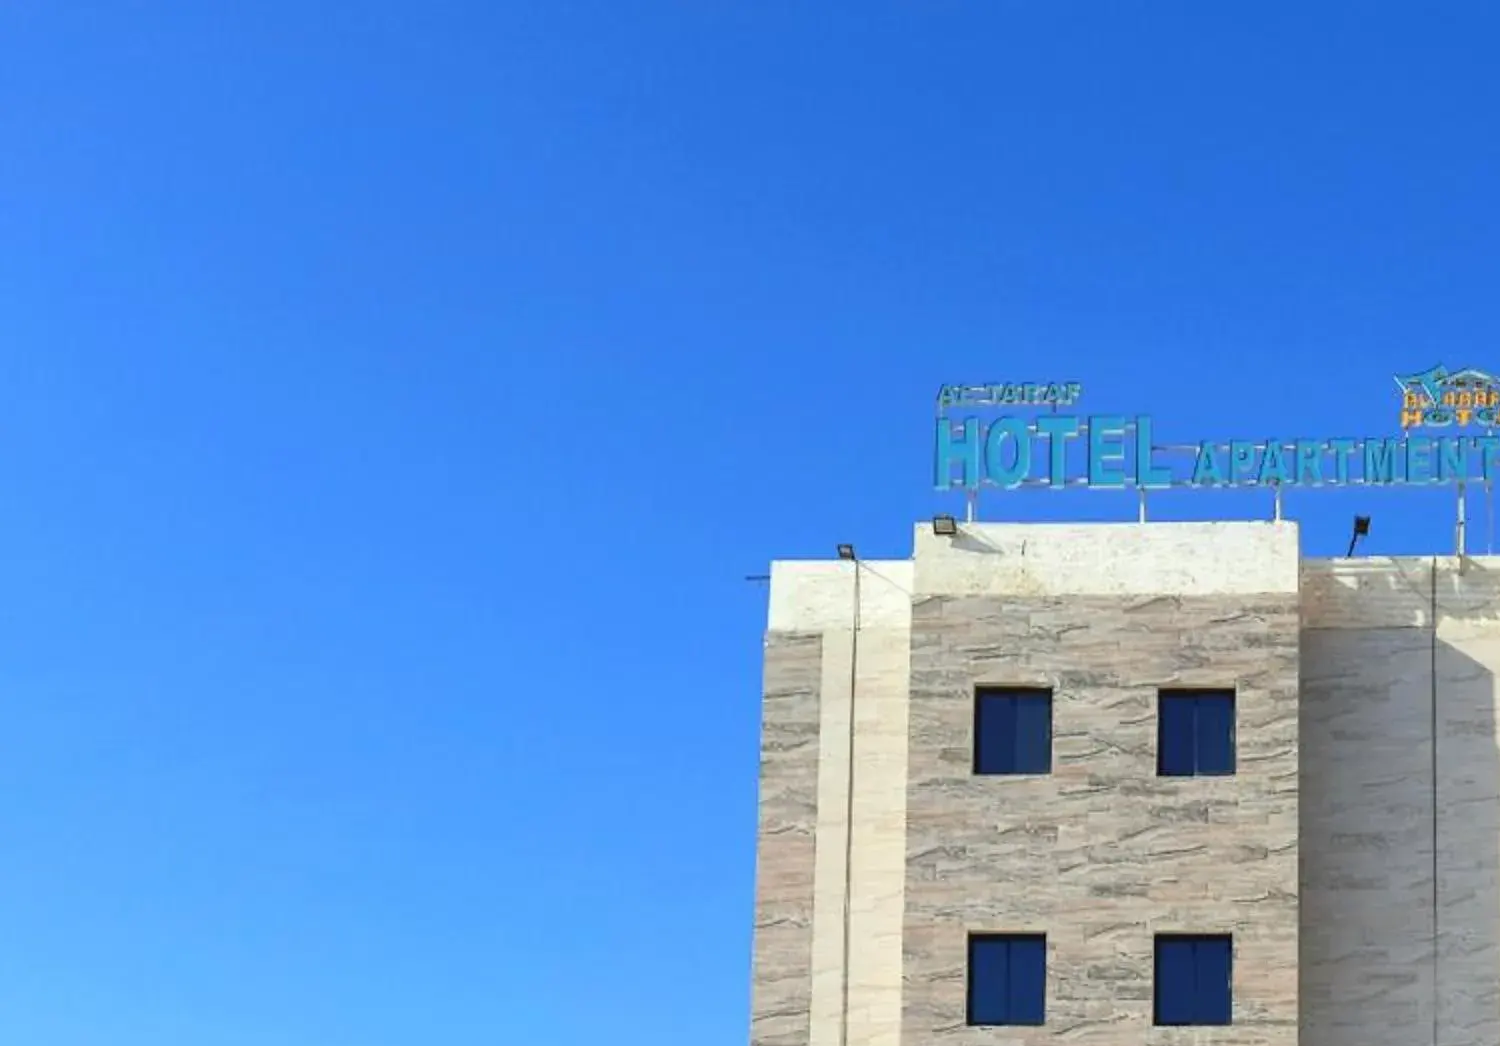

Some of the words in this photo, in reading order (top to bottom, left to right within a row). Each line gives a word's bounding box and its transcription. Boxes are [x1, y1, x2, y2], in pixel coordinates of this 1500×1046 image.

[984, 382, 1081, 406] TARAF
[934, 415, 1172, 490] HOTEL
[1191, 434, 1499, 487] APARTMENT
